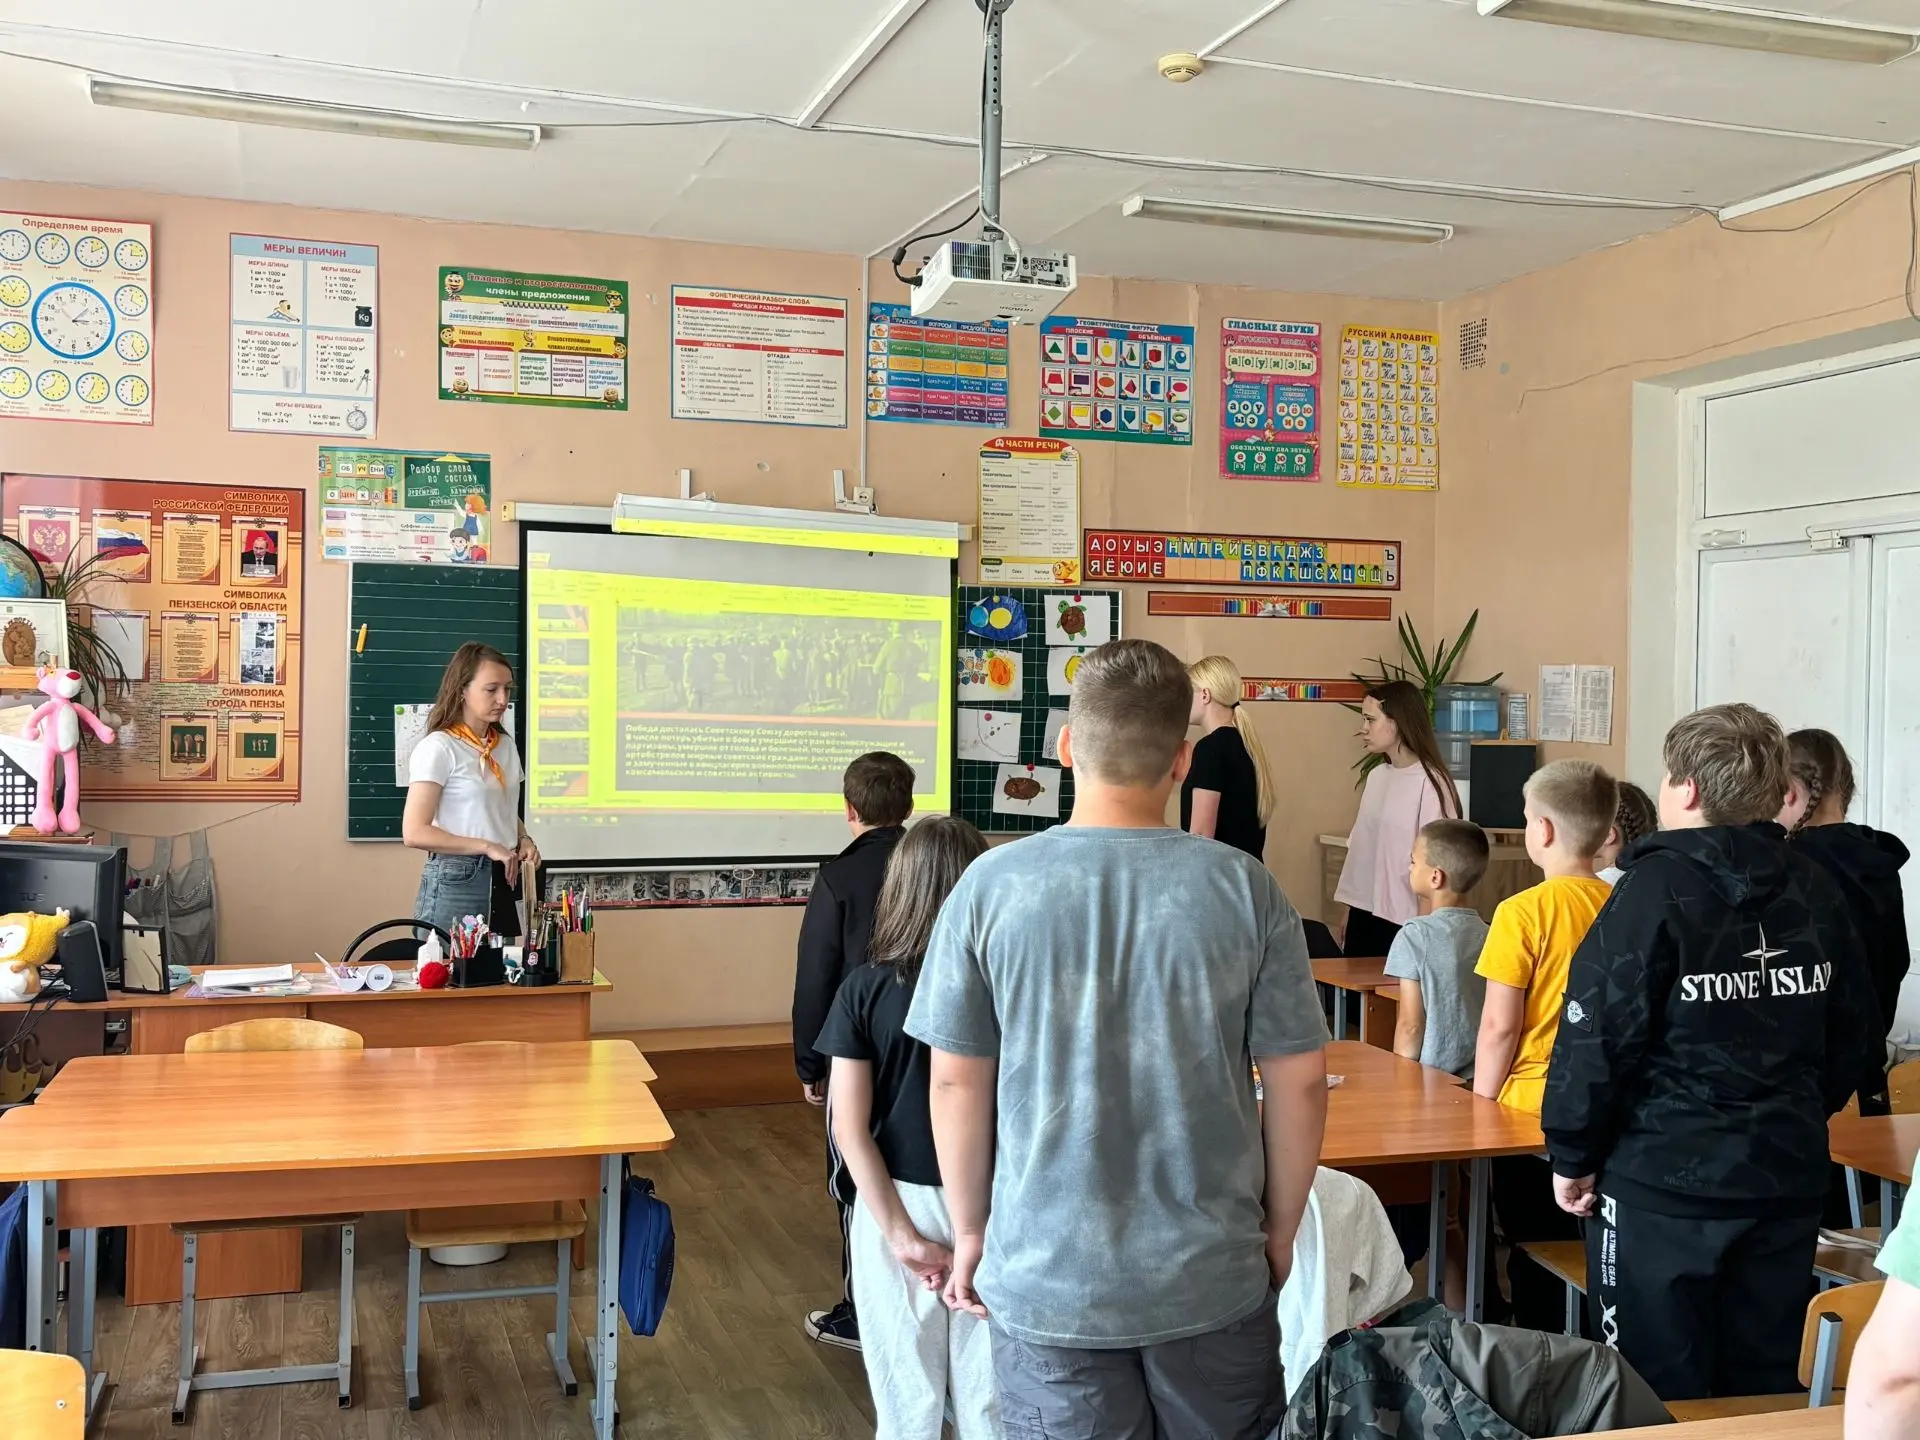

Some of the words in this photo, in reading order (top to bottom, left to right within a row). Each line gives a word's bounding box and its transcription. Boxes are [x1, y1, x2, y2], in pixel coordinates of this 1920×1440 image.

[22, 218, 89, 233] Определяем
[91, 226, 124, 236] время
[263, 243, 295, 254] МЕРЫ
[298, 246, 347, 258] ВЕЛИЧИН
[485, 288, 519, 298] члены
[521, 290, 590, 302] предложения
[709, 292, 761, 302] ФОНЕТИЧЕСКИЙ
[762, 295, 787, 304] РАЗБОР
[788, 297, 811, 306] СЛОВА
[358, 313, 370, 323] Kg
[1079, 320, 1131, 331] ГЕОМЕТРИЧЕСКИЕ
[1131, 324, 1156, 332] ФИГУРЫ
[1227, 320, 1277, 332] ГЛАСНЫЕ
[1280, 323, 1315, 334] ЗВУКИ
[1347, 328, 1387, 340] РУССКИЙ
[1389, 332, 1433, 343] АЛФАВИТ
[1006, 440, 1034, 449] ЧАСТИ
[1036, 441, 1060, 450] РЕЧИ
[410, 463, 441, 475] Разбор
[448, 464, 472, 473] слова
[427, 475, 438, 484] по
[444, 475, 478, 485] составу
[224, 491, 289, 504] СИМВОЛИКА
[153, 499, 225, 512] РОССИЙСКОЙ
[225, 503, 289, 516] ФЕДЕРАЦИИ
[223, 590, 287, 601] СИМВОЛИКА
[169, 599, 237, 611] ПЕНЗЕНСКОЙ
[239, 601, 287, 612] ОБЛАСТИ
[221, 688, 285, 698] СИМВОЛИКА
[207, 699, 247, 710] ГОРОДА
[249, 700, 285, 709] ПЕНЗЫ
[626, 725, 659, 734] Победа
[660, 726, 704, 735] досталась
[705, 726, 755, 737] Советскому
[757, 728, 782, 738] Союзу
[1681, 970, 1760, 1002] STONE
[1608, 1230, 1616, 1264] ULTIMATE
[1608, 1265, 1617, 1287] GEAR
